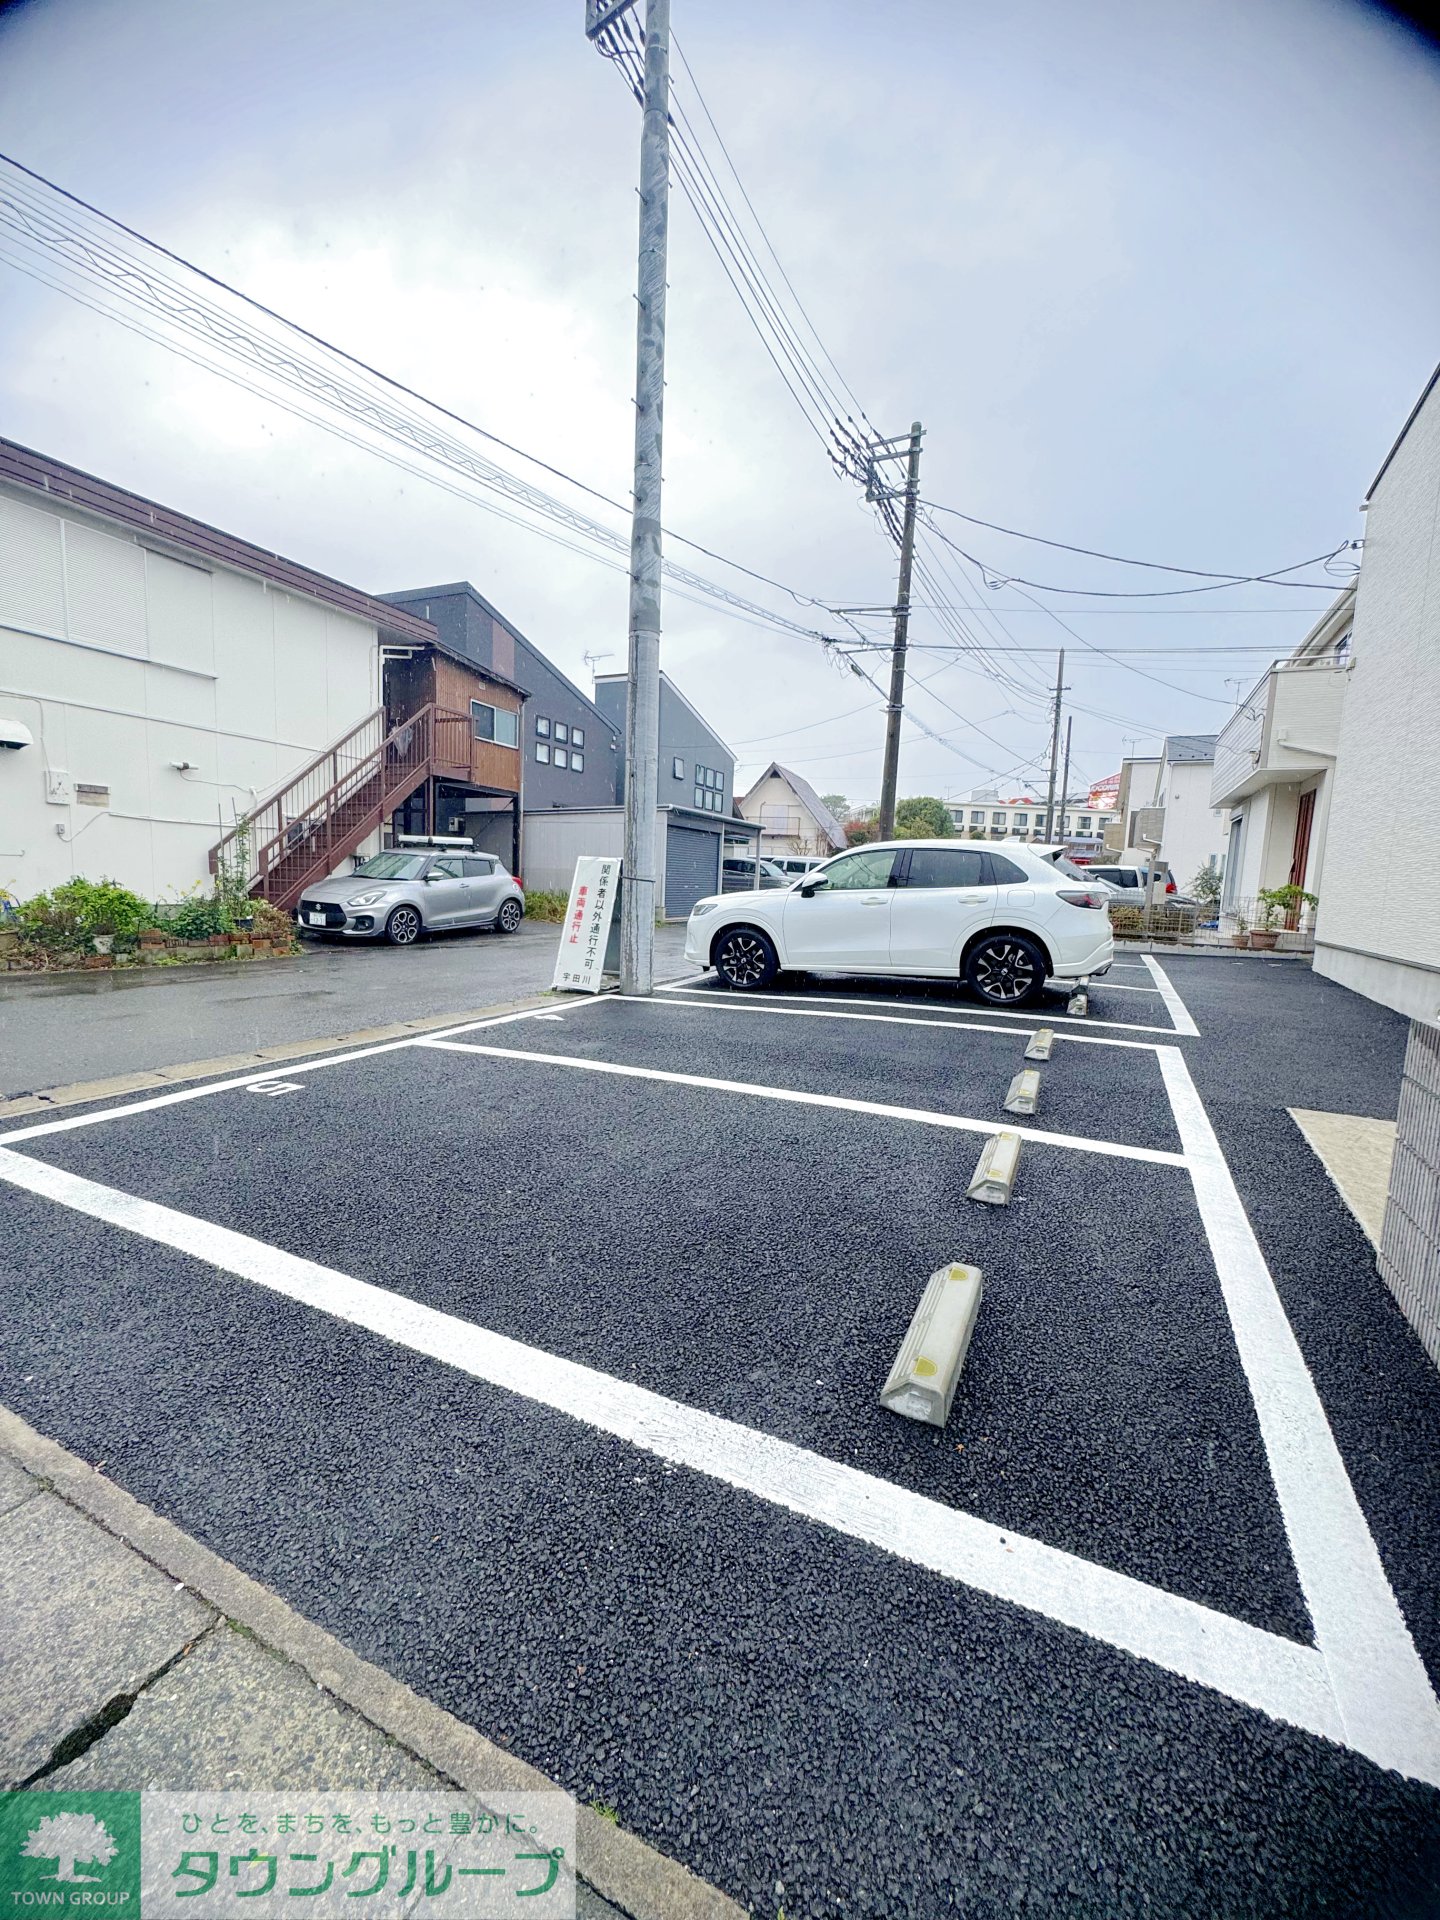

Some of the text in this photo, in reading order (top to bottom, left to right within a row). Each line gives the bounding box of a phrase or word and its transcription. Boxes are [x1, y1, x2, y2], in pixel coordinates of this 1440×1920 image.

[569, 886, 588, 944] 車両通行止
[585, 864, 611, 970] 関係者以外通行不可
[246, 1080, 306, 1097] 5
